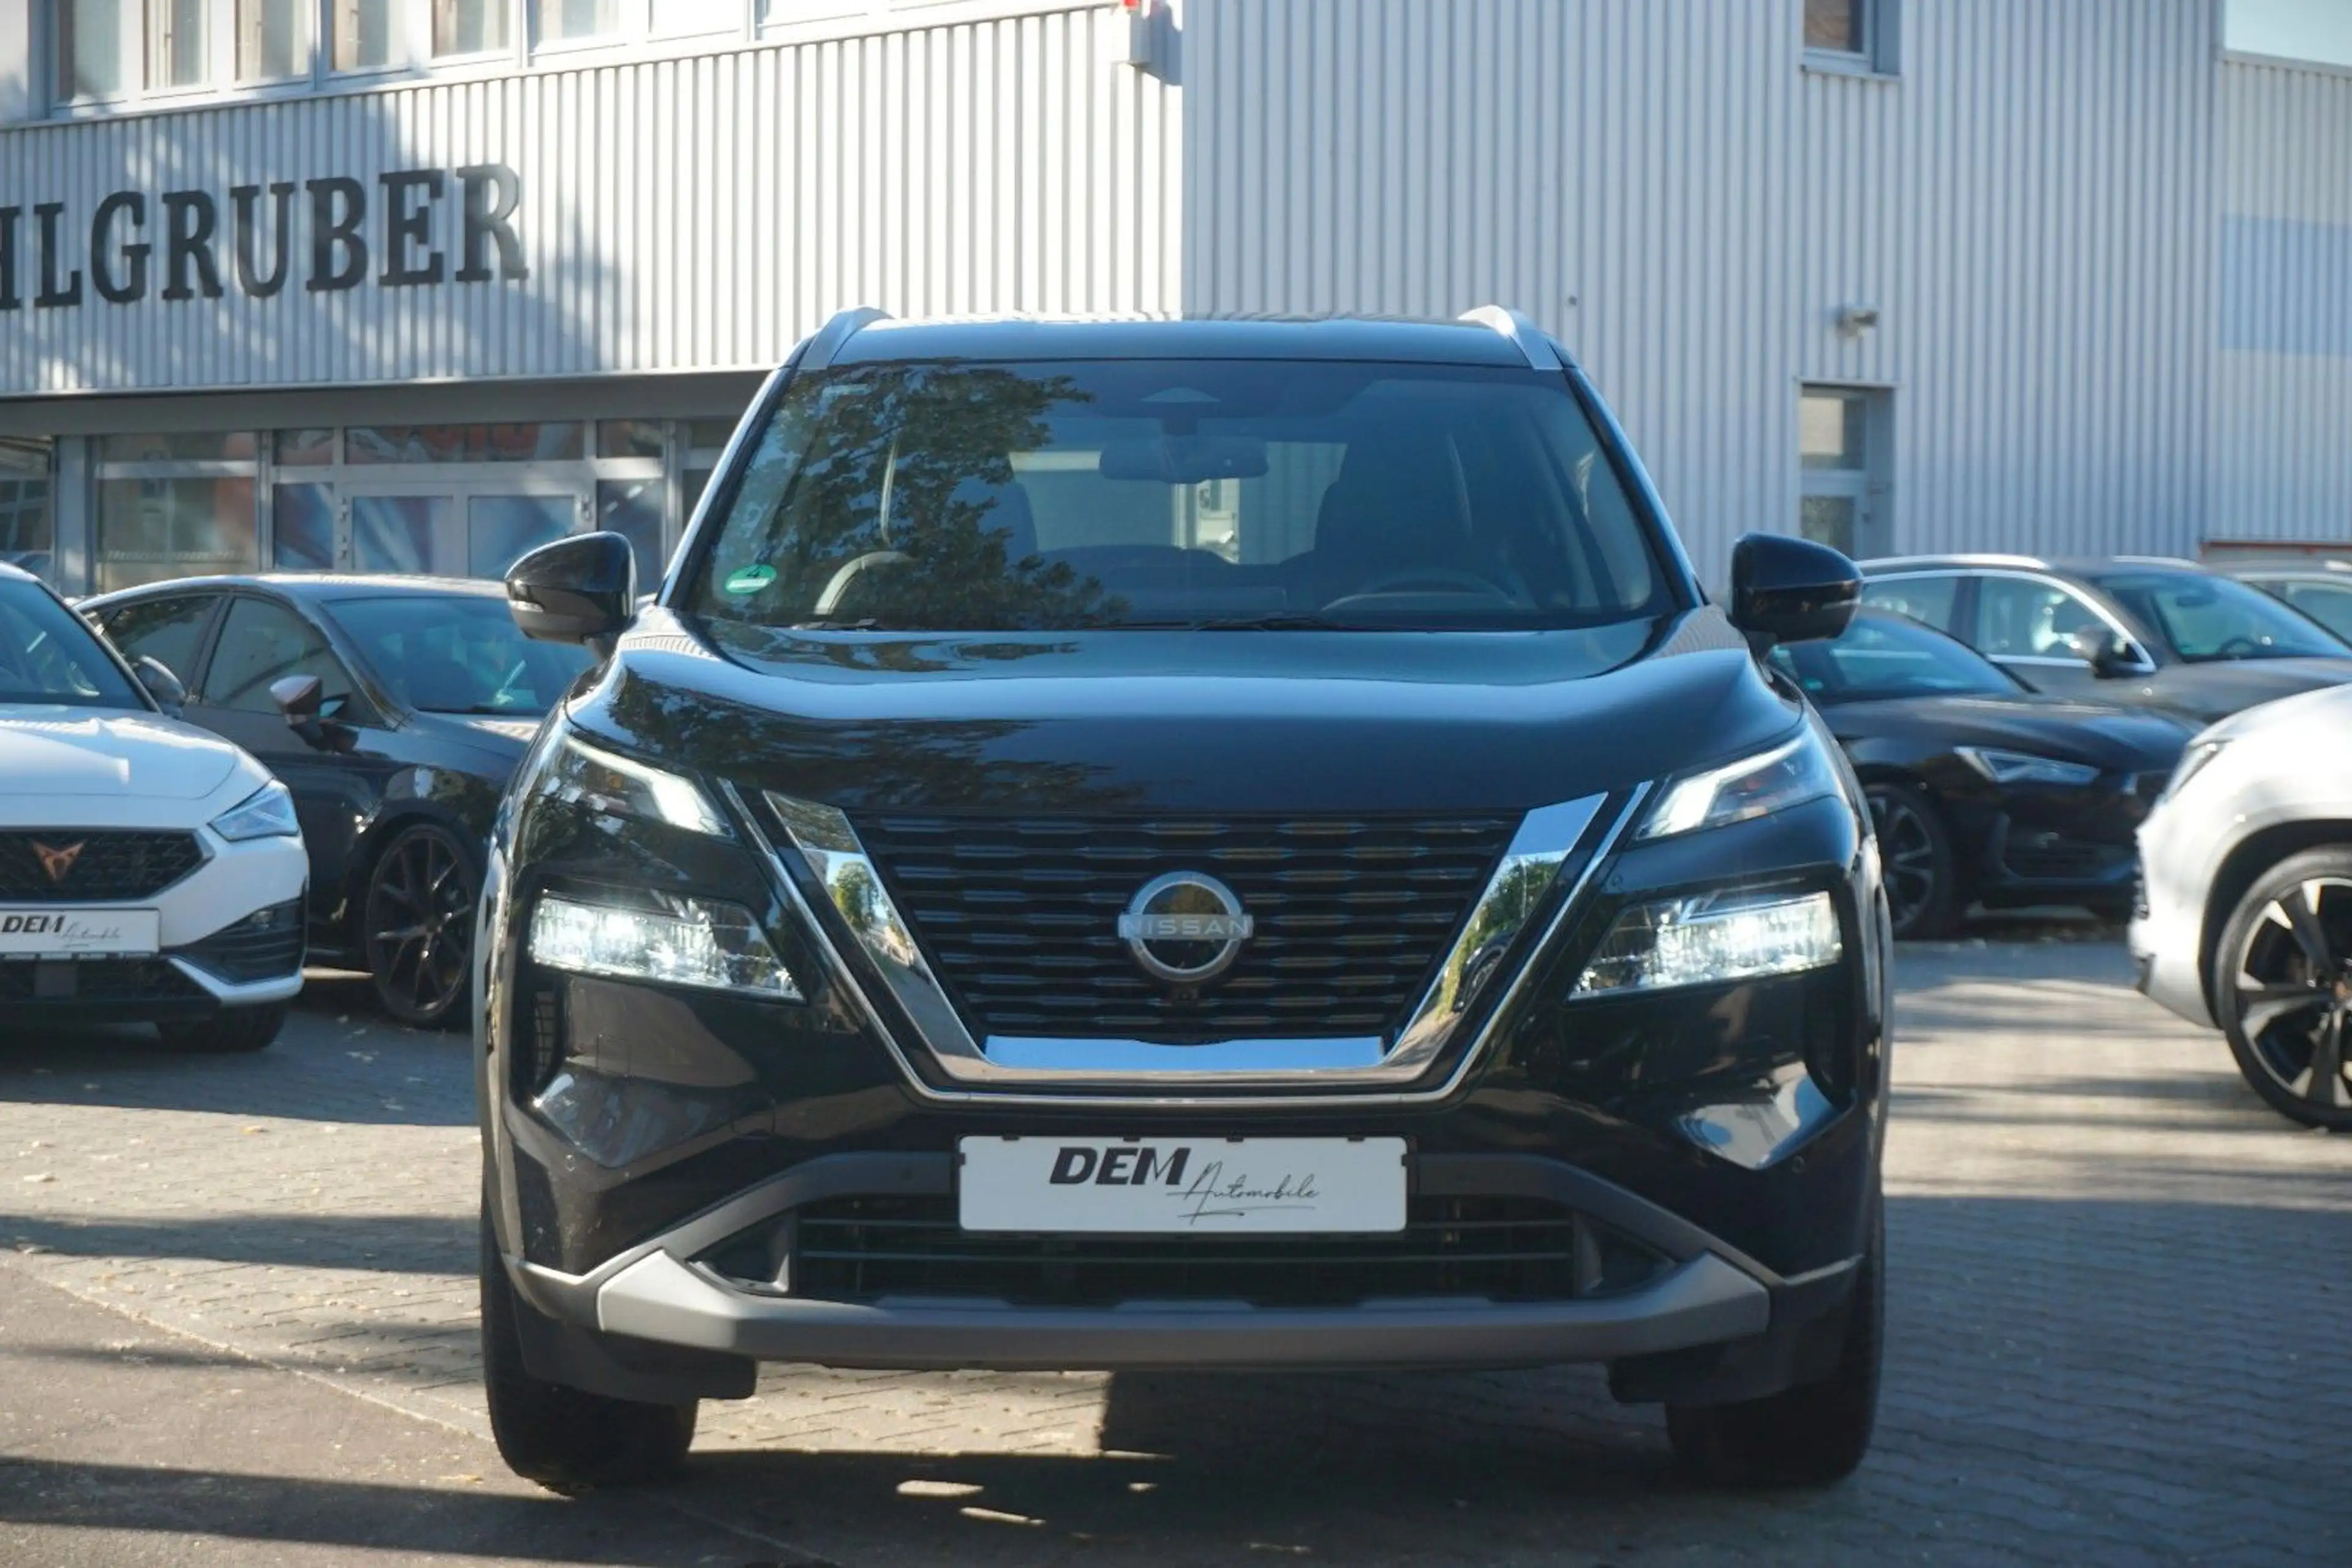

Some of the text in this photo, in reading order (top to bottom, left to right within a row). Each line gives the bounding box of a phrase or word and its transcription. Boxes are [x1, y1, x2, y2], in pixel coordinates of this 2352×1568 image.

[1, 915, 67, 933] DEM
[1122, 919, 1249, 936] NISSAN
[1049, 1147, 1320, 1225] DEM Automobile
